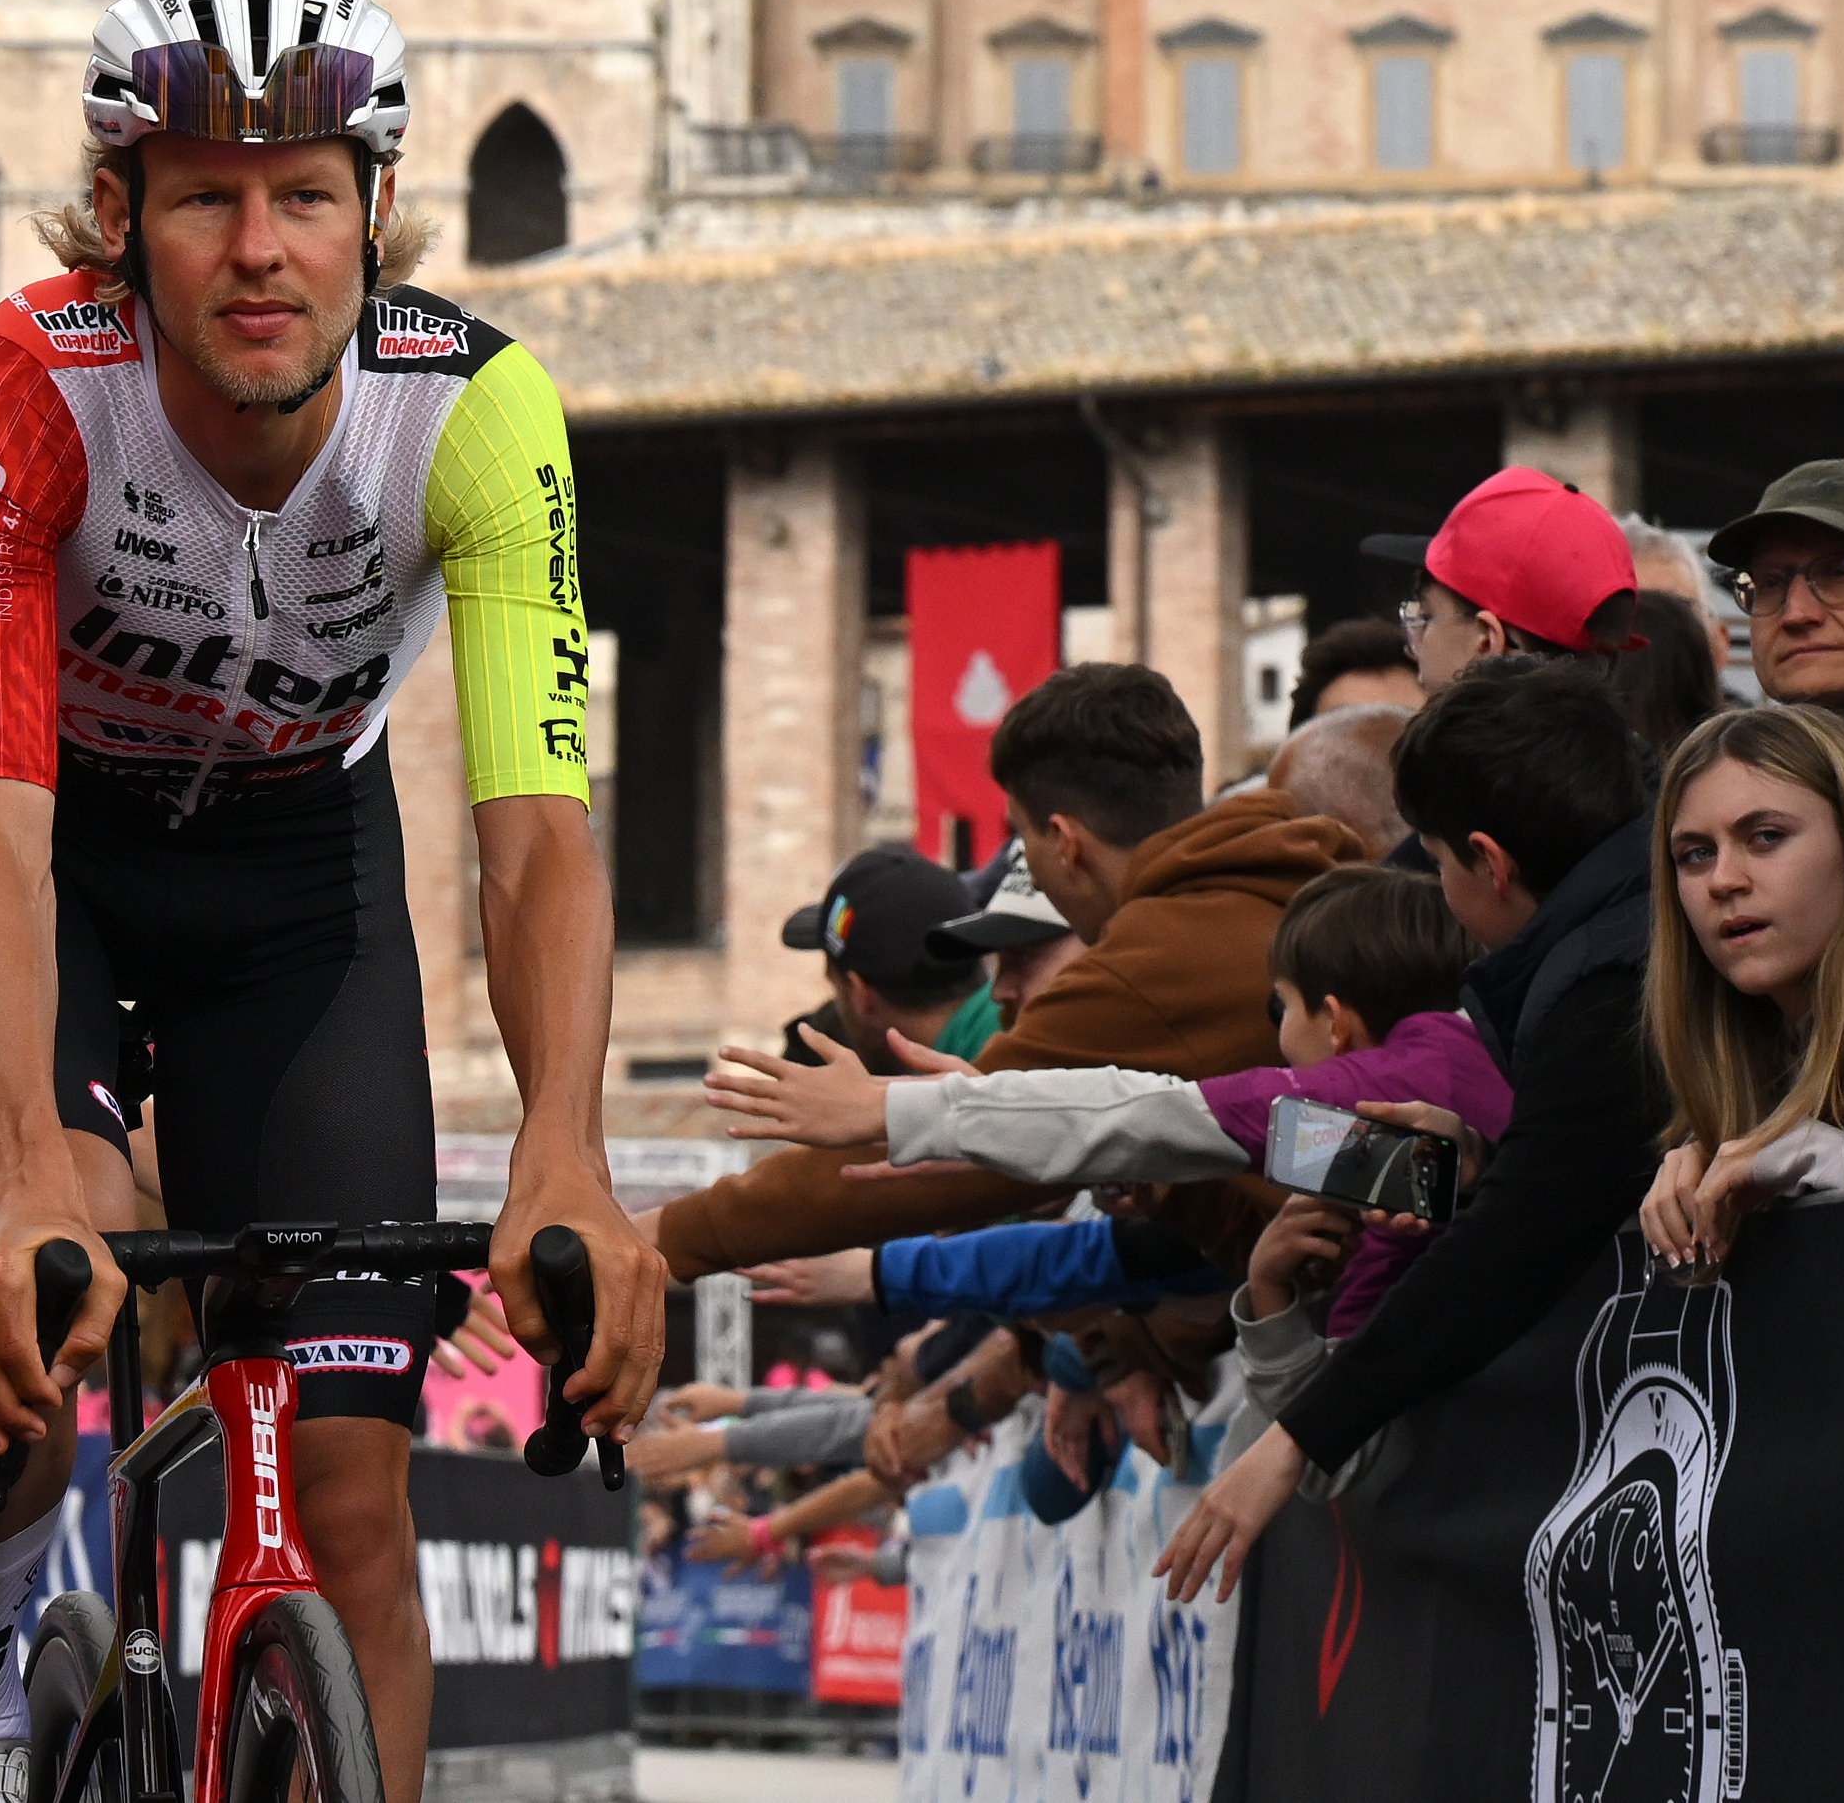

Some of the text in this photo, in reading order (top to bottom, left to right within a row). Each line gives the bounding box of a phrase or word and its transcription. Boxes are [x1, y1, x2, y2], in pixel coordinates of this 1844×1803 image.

[144, 490, 163, 504] UCI
[143, 510, 167, 525] TEAM
[144, 501, 176, 519] WORLD
[114, 528, 179, 566] uvex
[128, 585, 226, 620] NIPPO
[548, 693, 573, 704] VAN
[267, 1231, 322, 1244] bryton
[290, 1344, 401, 1365] WANTY
[249, 1383, 282, 1549] CUBE
[133, 1647, 154, 1656] UCI
